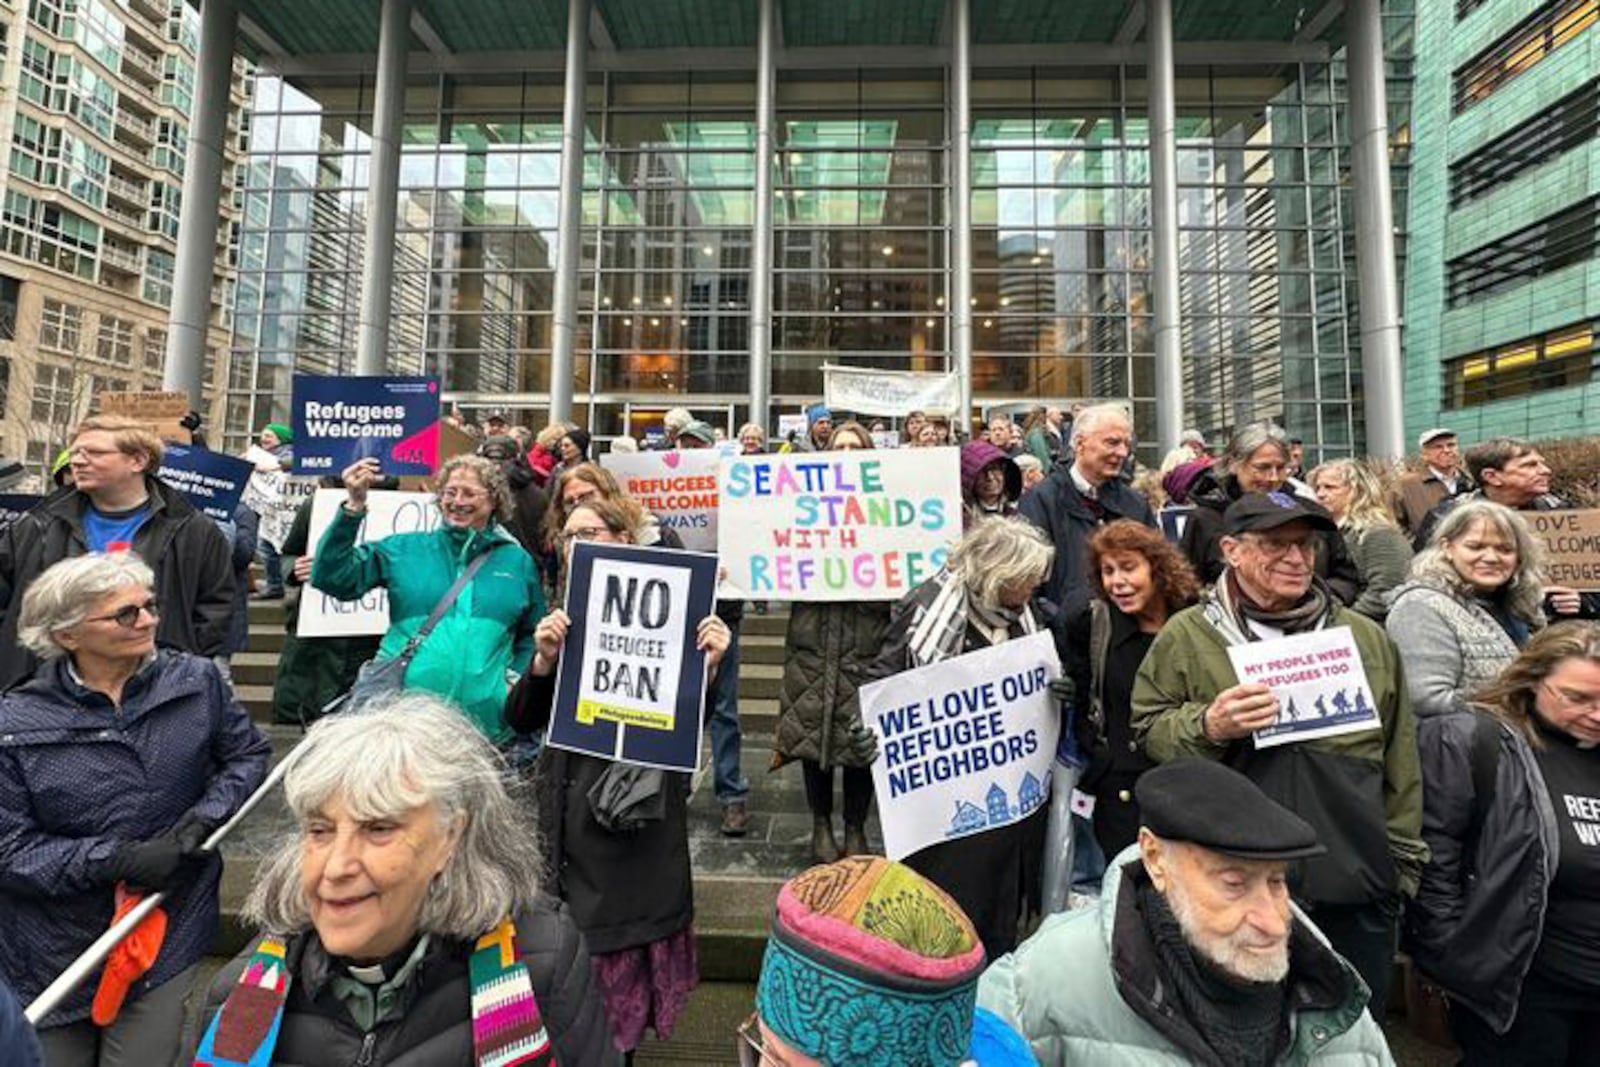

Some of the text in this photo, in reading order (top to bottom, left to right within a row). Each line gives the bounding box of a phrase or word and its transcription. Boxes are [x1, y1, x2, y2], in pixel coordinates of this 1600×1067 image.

[305, 401, 405, 423] Refugees
[305, 420, 404, 438] Welcome
[301, 457, 332, 468] HIAS
[158, 466, 203, 483] people
[203, 477, 235, 491] were
[628, 475, 717, 494] REFUGEES
[727, 460, 883, 498] SEATTLE
[662, 513, 708, 528] WAYS
[795, 495, 945, 530] STANDS
[1535, 514, 1582, 534] OVE
[773, 528, 857, 548] WITH
[602, 574, 671, 630] NO
[599, 633, 669, 659] REFUGEE
[1244, 646, 1352, 675] MY PEOPLE WERE
[1322, 662, 1350, 677] TOO
[593, 658, 661, 703] BAN
[878, 666, 1049, 738] WE LOVE OUR
[883, 711, 1005, 769] REFUGEE
[887, 729, 1039, 799] NEIGHBORS
[1563, 794, 1600, 820] REF
